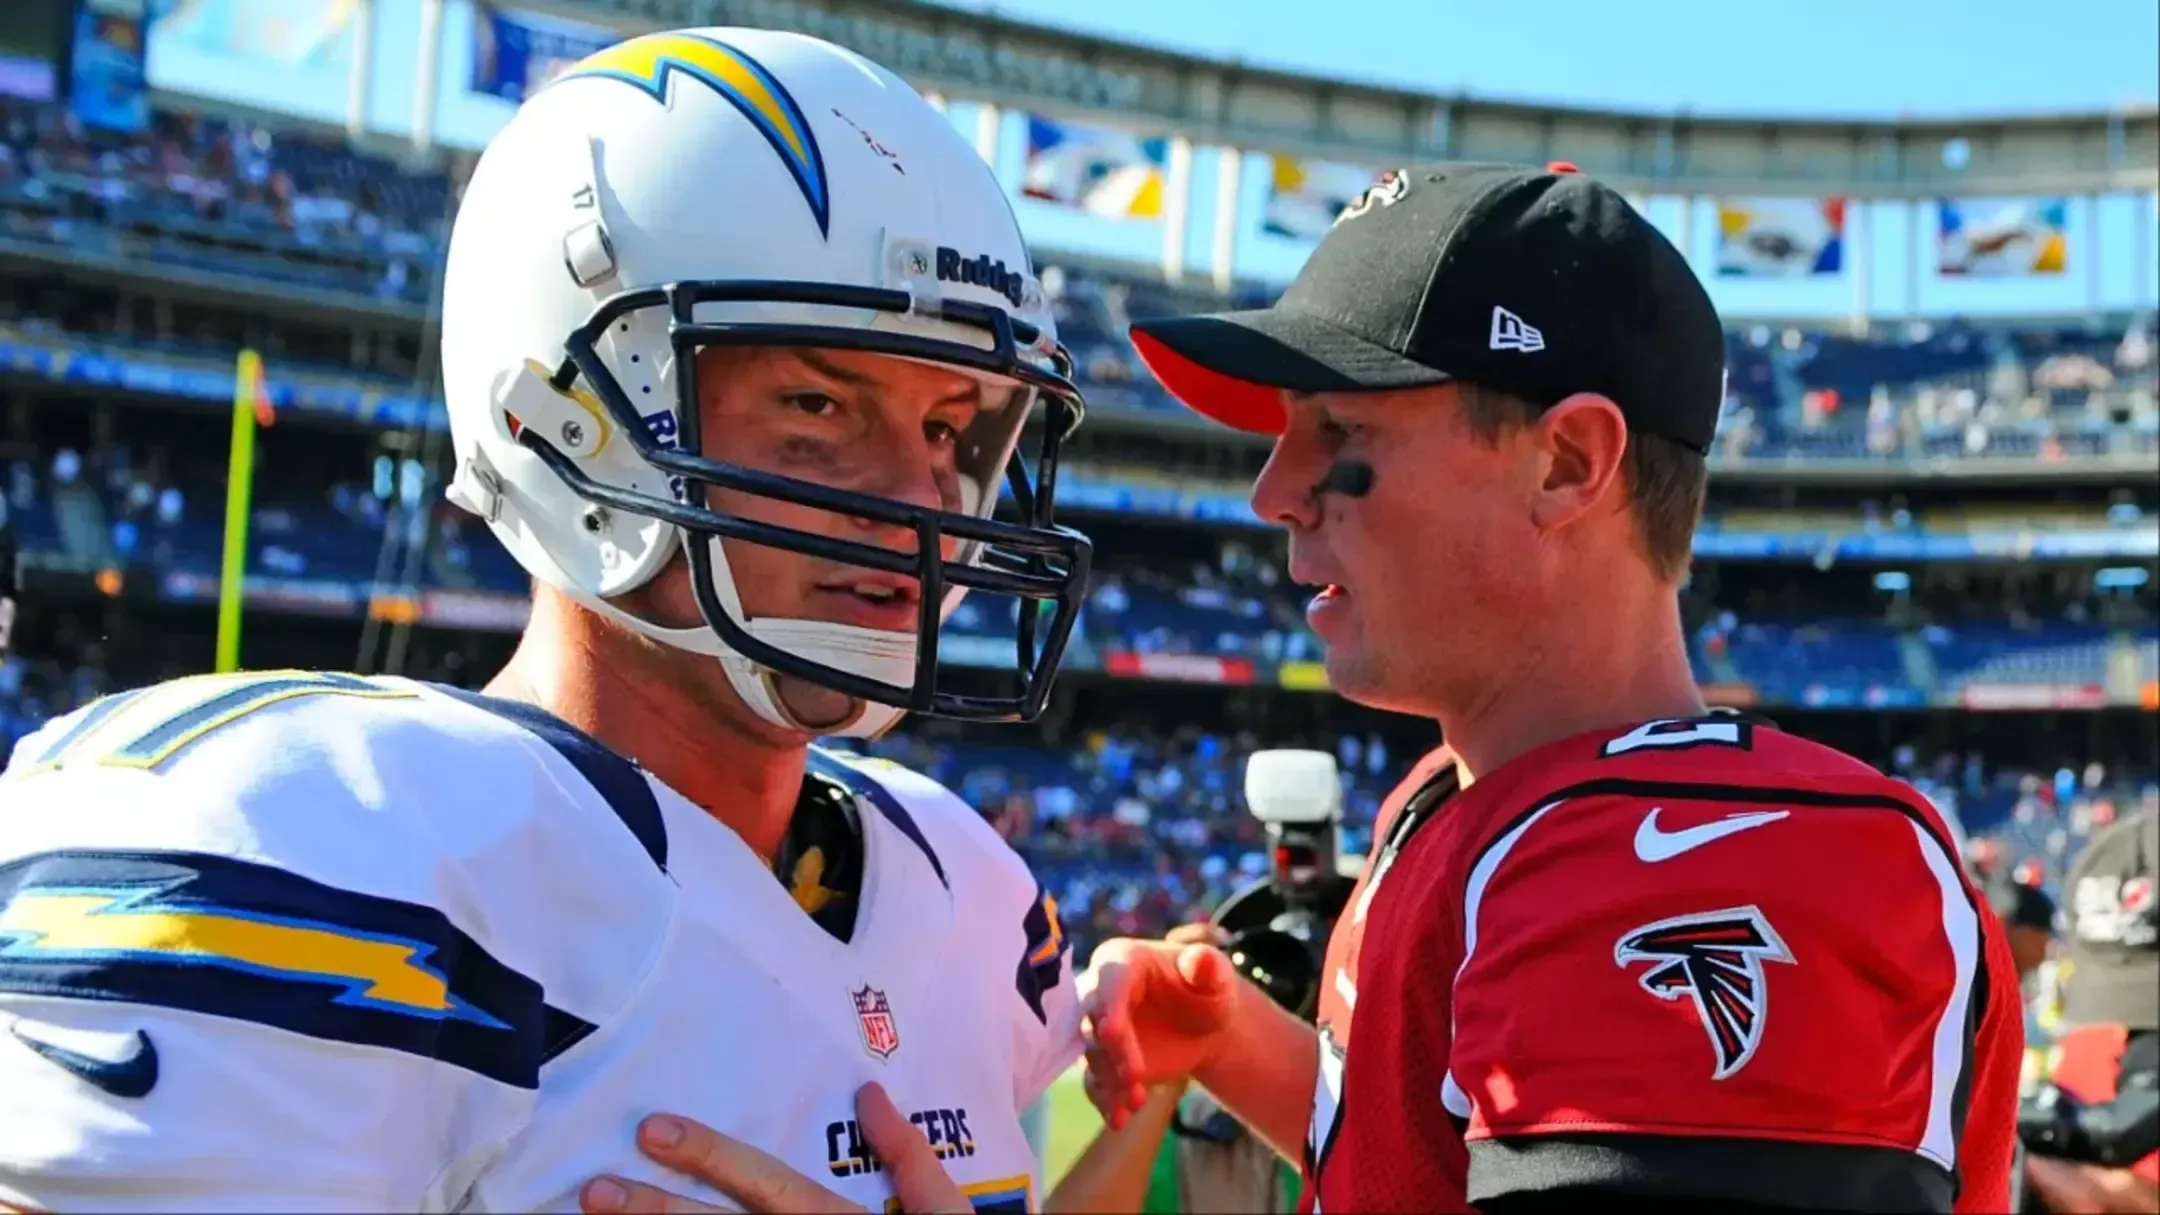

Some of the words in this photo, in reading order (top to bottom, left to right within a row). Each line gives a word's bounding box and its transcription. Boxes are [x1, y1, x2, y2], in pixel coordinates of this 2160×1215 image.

[572, 182, 595, 210] 17
[863, 1014, 897, 1050] NFL
[826, 1108, 976, 1178] CHERS
